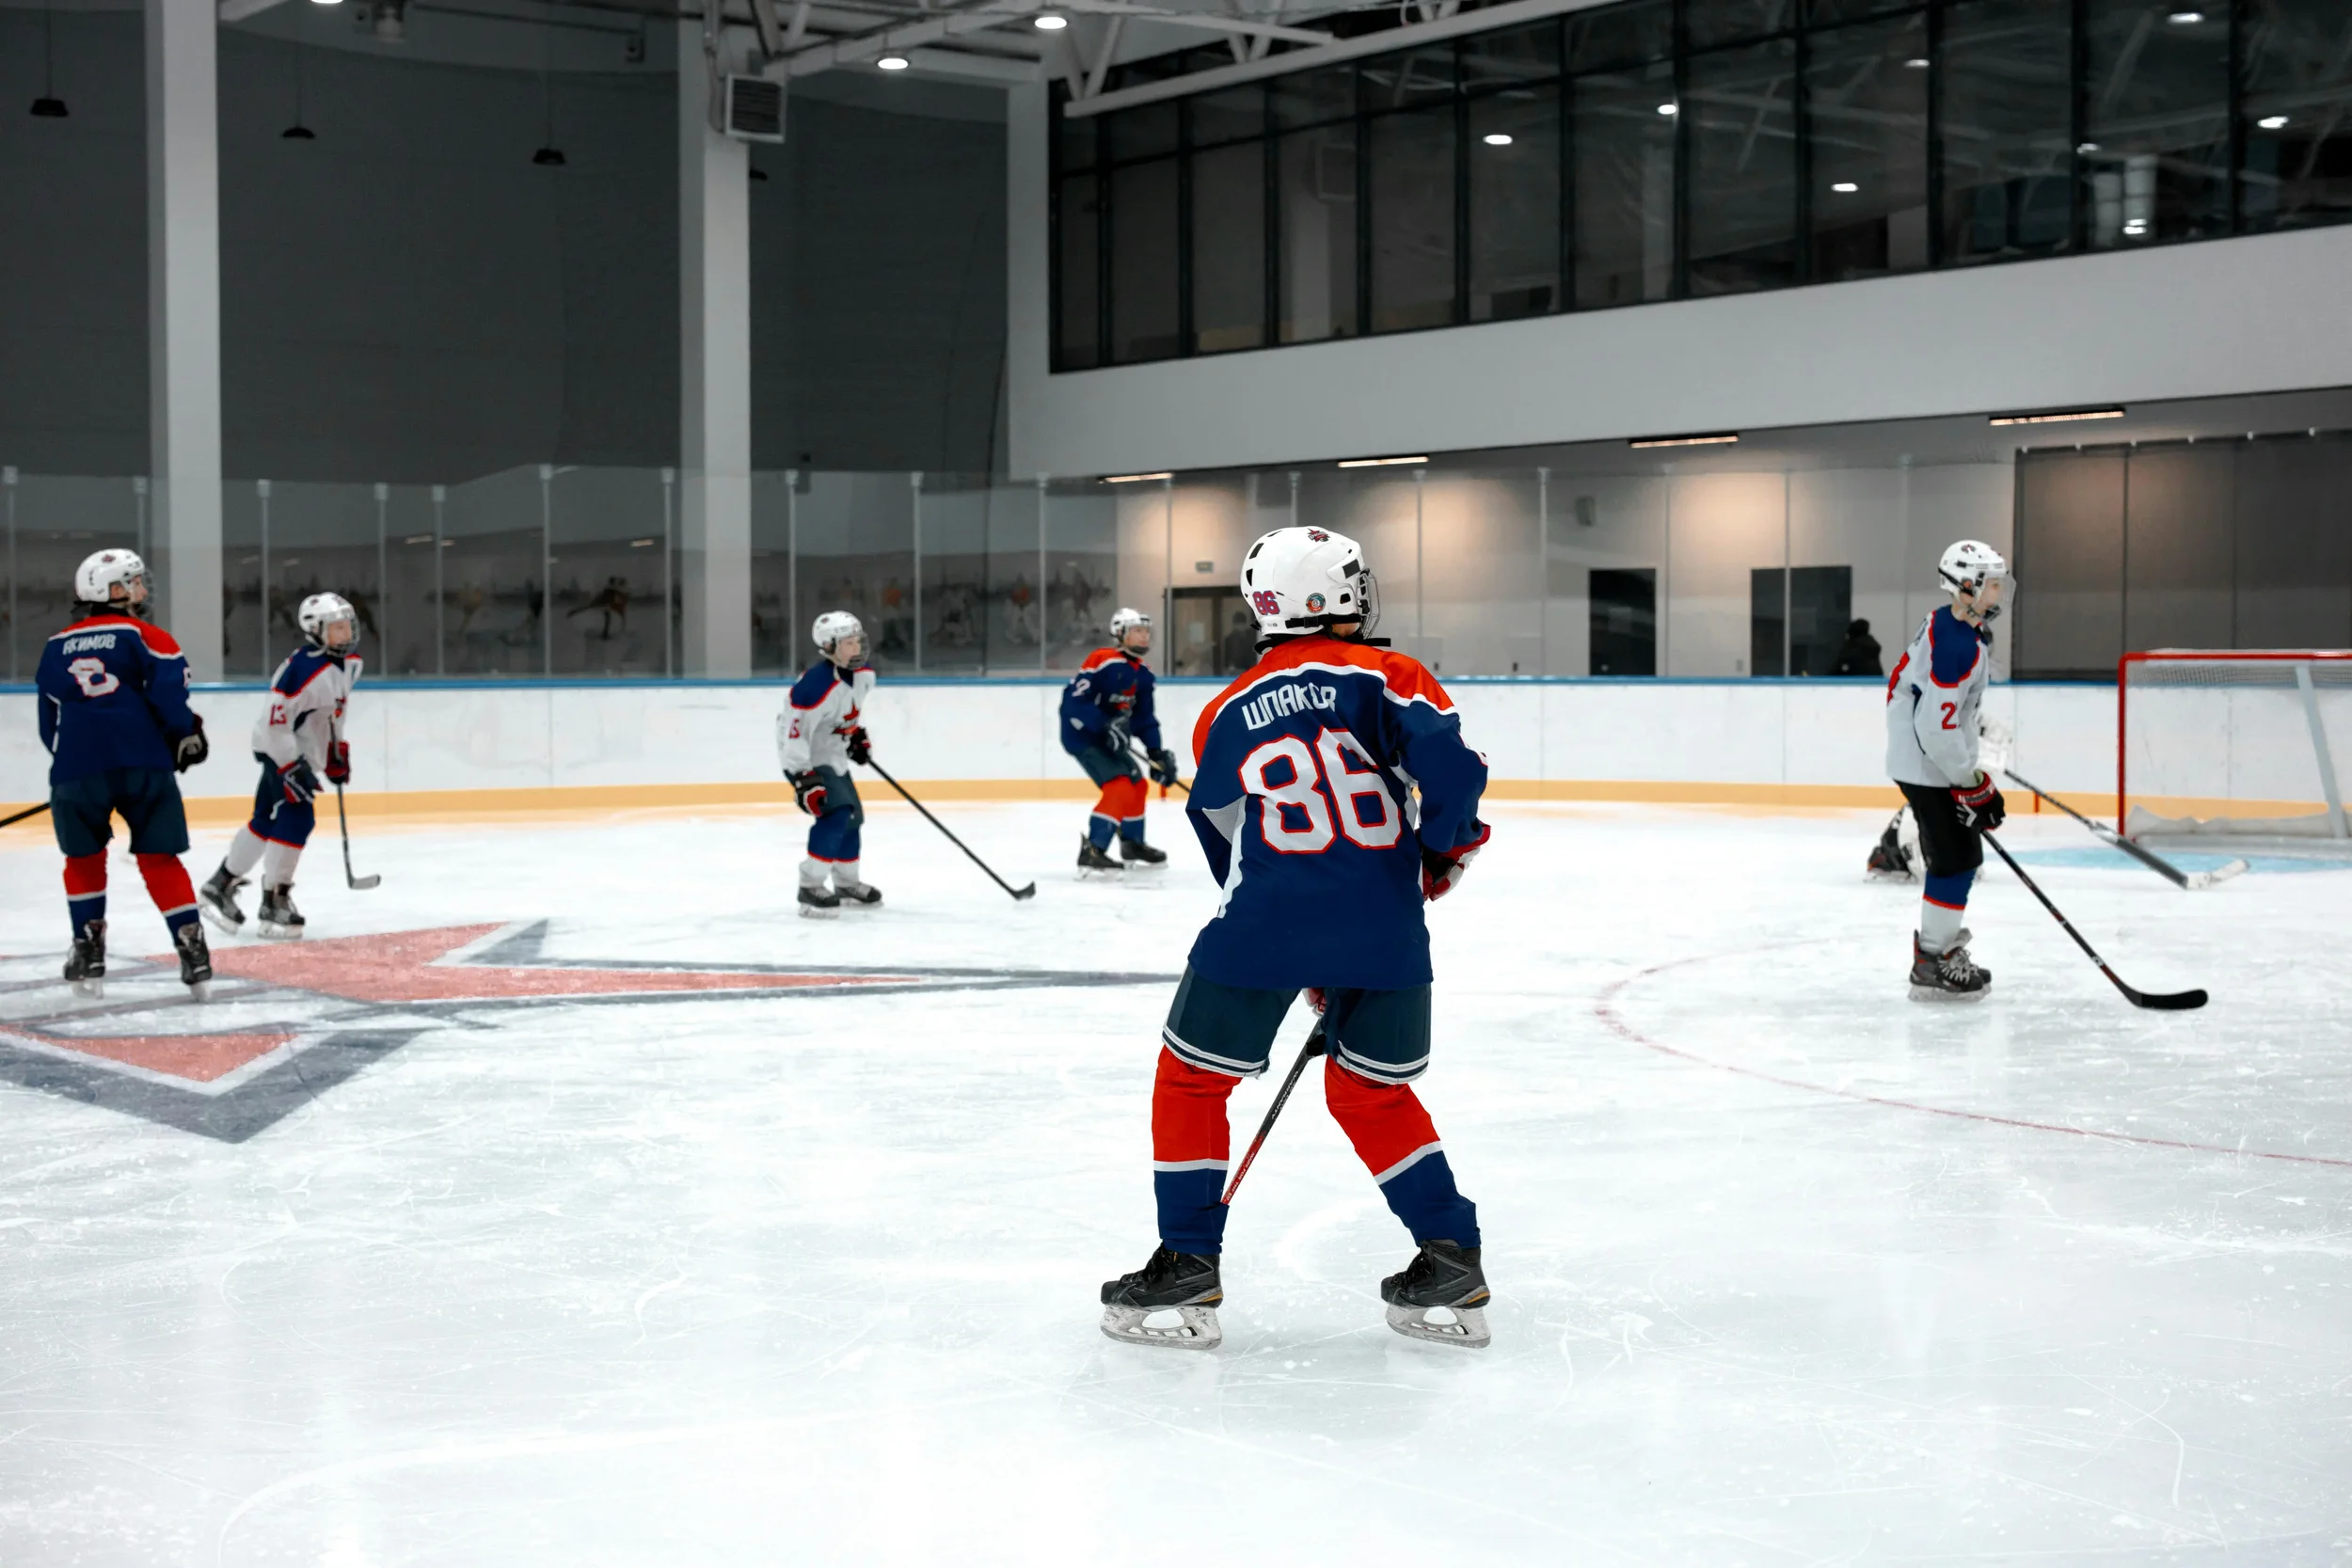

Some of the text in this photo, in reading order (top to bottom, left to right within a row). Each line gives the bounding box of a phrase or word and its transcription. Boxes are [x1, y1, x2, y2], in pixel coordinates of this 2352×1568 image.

[1252, 590, 1280, 615] 86
[1940, 702, 1961, 730] 2
[1237, 724, 1403, 854] 86
